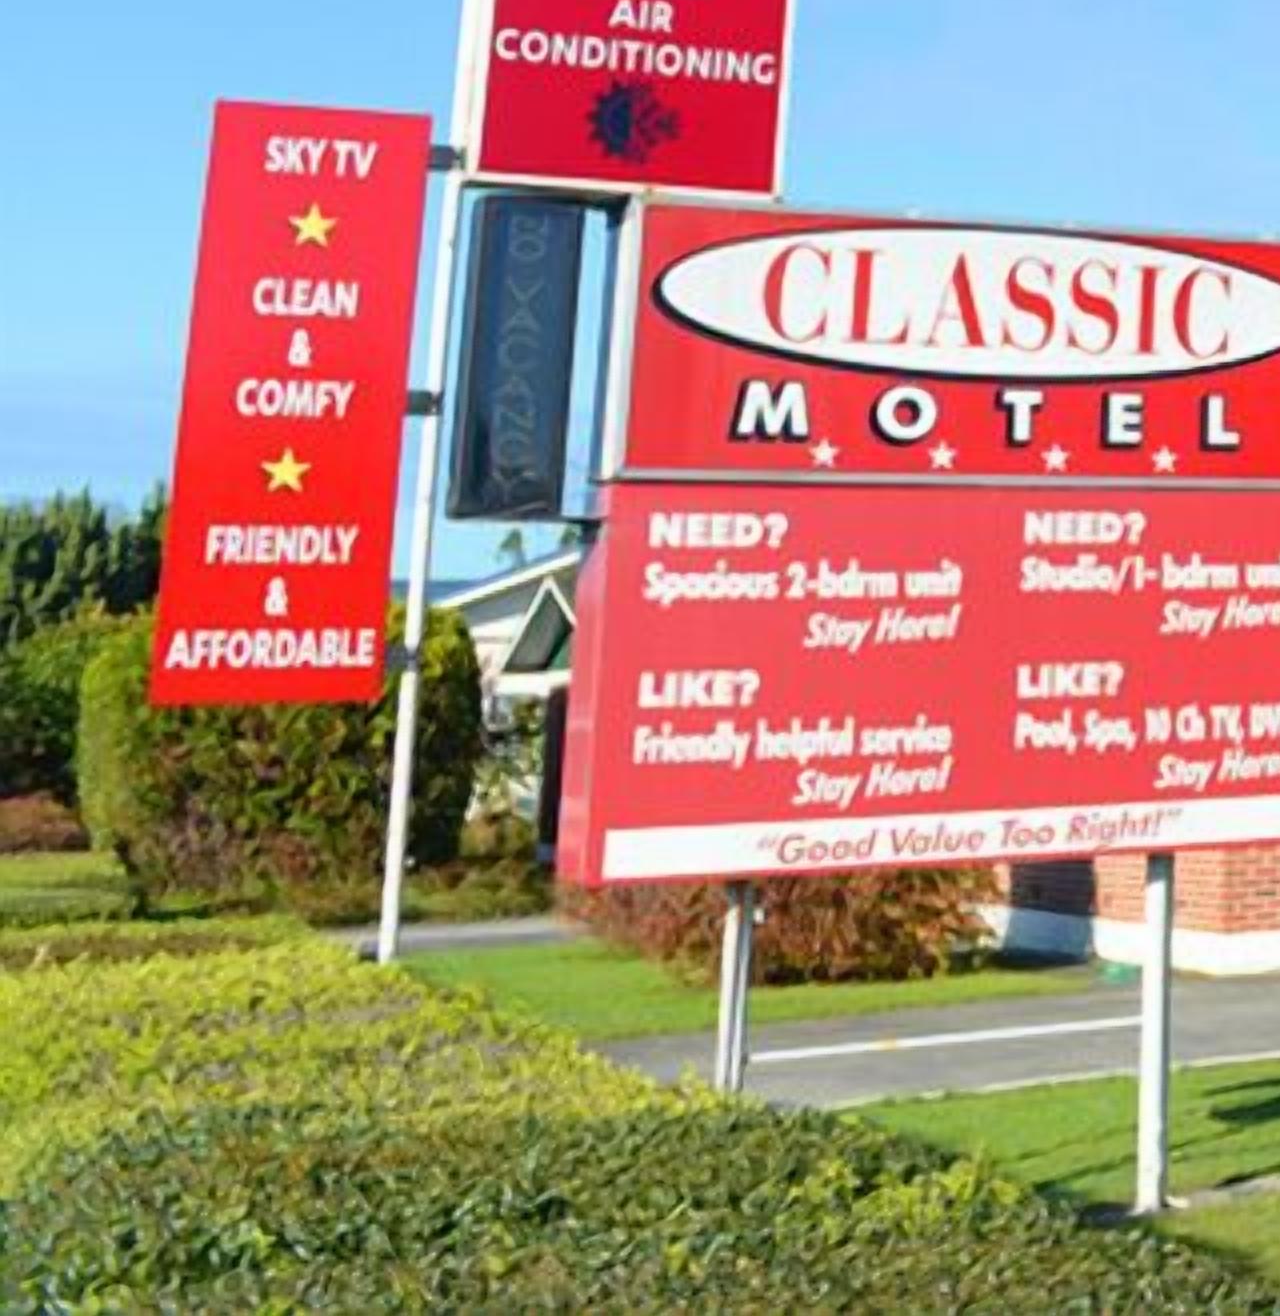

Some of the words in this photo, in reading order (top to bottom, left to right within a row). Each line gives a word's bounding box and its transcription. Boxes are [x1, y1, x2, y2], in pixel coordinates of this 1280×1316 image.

[496, 28, 776, 85] CONDITIONING
[265, 136, 328, 176] SKY
[333, 140, 378, 179] TV
[252, 278, 358, 318] CLEAN
[764, 243, 1234, 360] CLASSIC
[287, 328, 312, 369] &
[235, 379, 354, 419] COMFY
[730, 380, 1241, 449] MOTEL
[204, 525, 359, 566] FRIENDLY
[648, 512, 789, 548] NEED?
[1023, 511, 1146, 545] NEED?
[264, 577, 289, 618] &
[643, 560, 780, 606] Spacious
[804, 613, 872, 651] Stay
[875, 604, 962, 644] Here!
[1160, 601, 1220, 637] Stay
[165, 628, 377, 670] AFFORDABLE
[637, 670, 761, 708] LIKE?
[1016, 662, 1124, 699] LIKE?
[633, 720, 750, 768] Friendly
[755, 717, 854, 762] helpful
[860, 715, 953, 756] service
[1014, 710, 1078, 754] Pool,
[1083, 711, 1137, 751] Spa,
[792, 768, 861, 809] Stay
[865, 757, 953, 797] Here!
[1153, 754, 1216, 792] Stay
[891, 820, 986, 856] Value
[1000, 817, 1056, 848] Too
